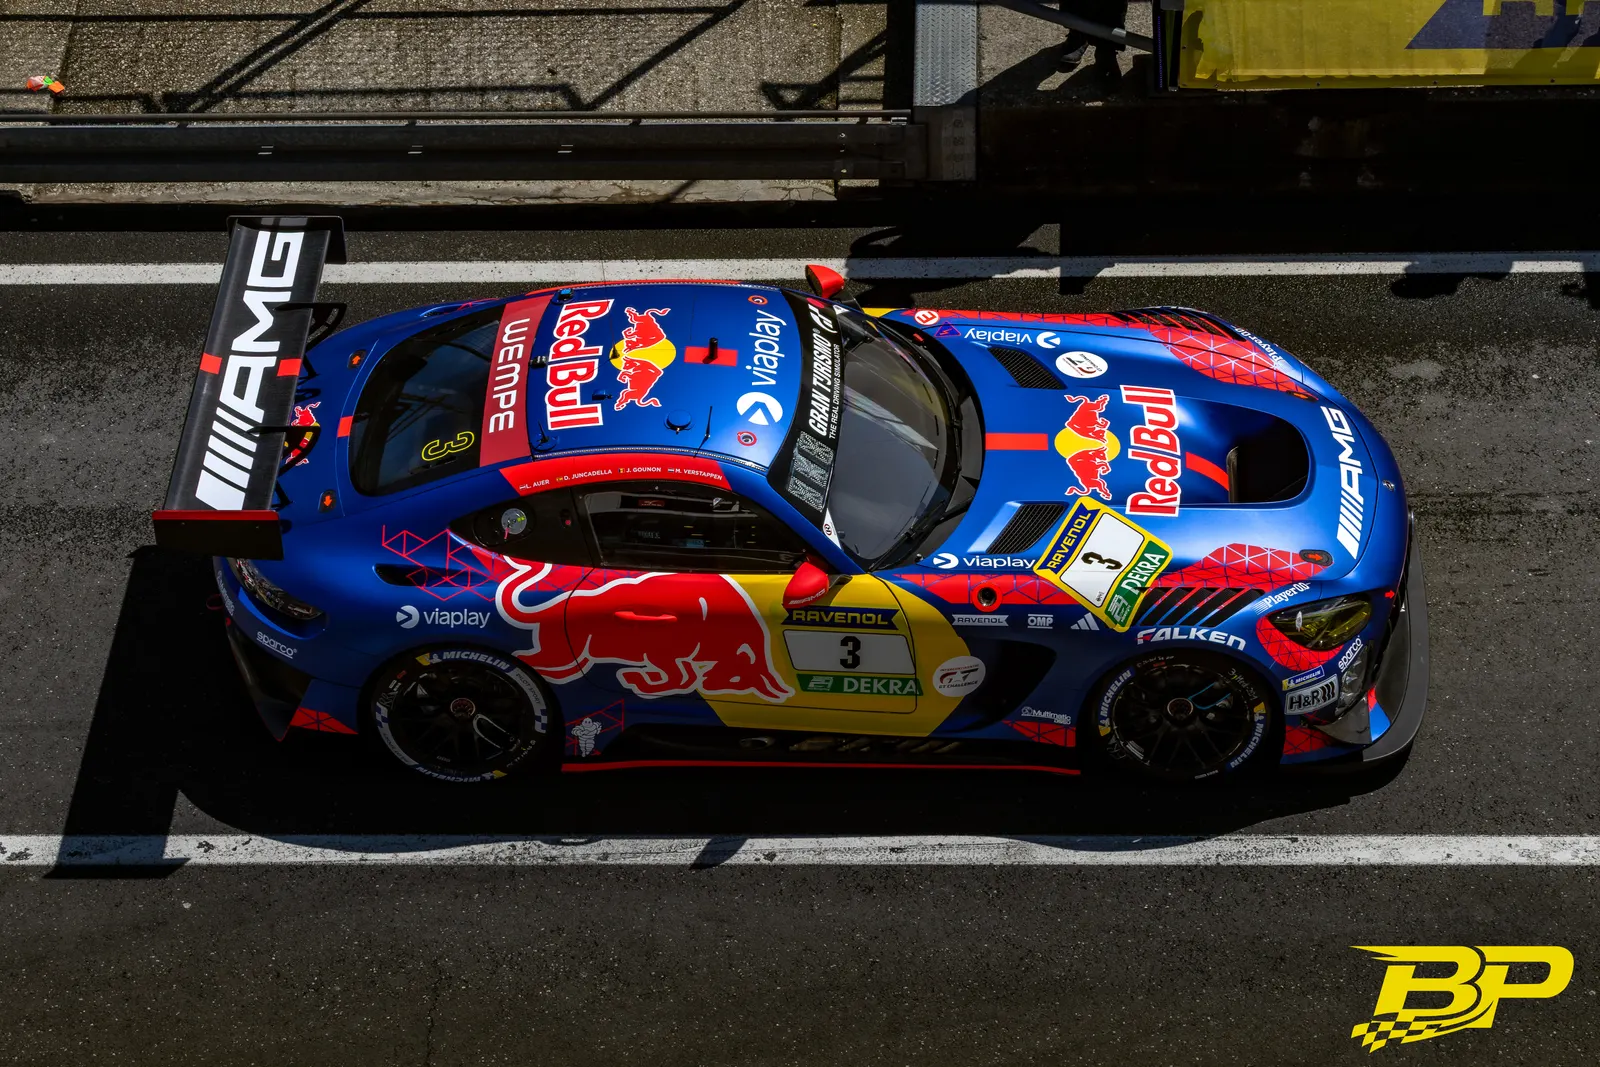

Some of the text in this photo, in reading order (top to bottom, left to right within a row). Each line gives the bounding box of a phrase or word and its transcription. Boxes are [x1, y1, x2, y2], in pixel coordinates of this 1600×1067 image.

[749, 309, 787, 387] viaplay
[964, 328, 1033, 346] viaplay
[488, 317, 530, 434] WEMPE
[545, 299, 615, 431] Red Bull
[829, 343, 841, 439] THE REAL DRIVING SIMULATOR
[808, 390, 831, 437] GRAN
[422, 431, 475, 461] 3
[1120, 385, 1182, 517] Red Bull
[532, 479, 550, 489] AUER
[571, 469, 613, 480] JUNCADELLA
[683, 469, 723, 481] VERSTAPPEN
[1046, 510, 1092, 569] RAVENOL
[963, 555, 1037, 570] viaplay
[1080, 550, 1124, 571] 3
[1124, 549, 1167, 595] DEKRA
[423, 608, 491, 628] viaplay
[792, 609, 889, 626] RAVENOL
[956, 615, 1004, 625] RAVENOL
[1027, 615, 1053, 627] OMP
[1136, 627, 1247, 651] FALKEN
[442, 650, 511, 670] MICHELIN
[839, 635, 861, 669] 3
[1337, 635, 1363, 670] sparco
[843, 677, 920, 695] DEKRA
[1295, 670, 1322, 684] MICHELIN
[1100, 669, 1132, 717] MICHELIN
[1289, 690, 1321, 710] H&R
[1229, 722, 1264, 769] MICHELIN
